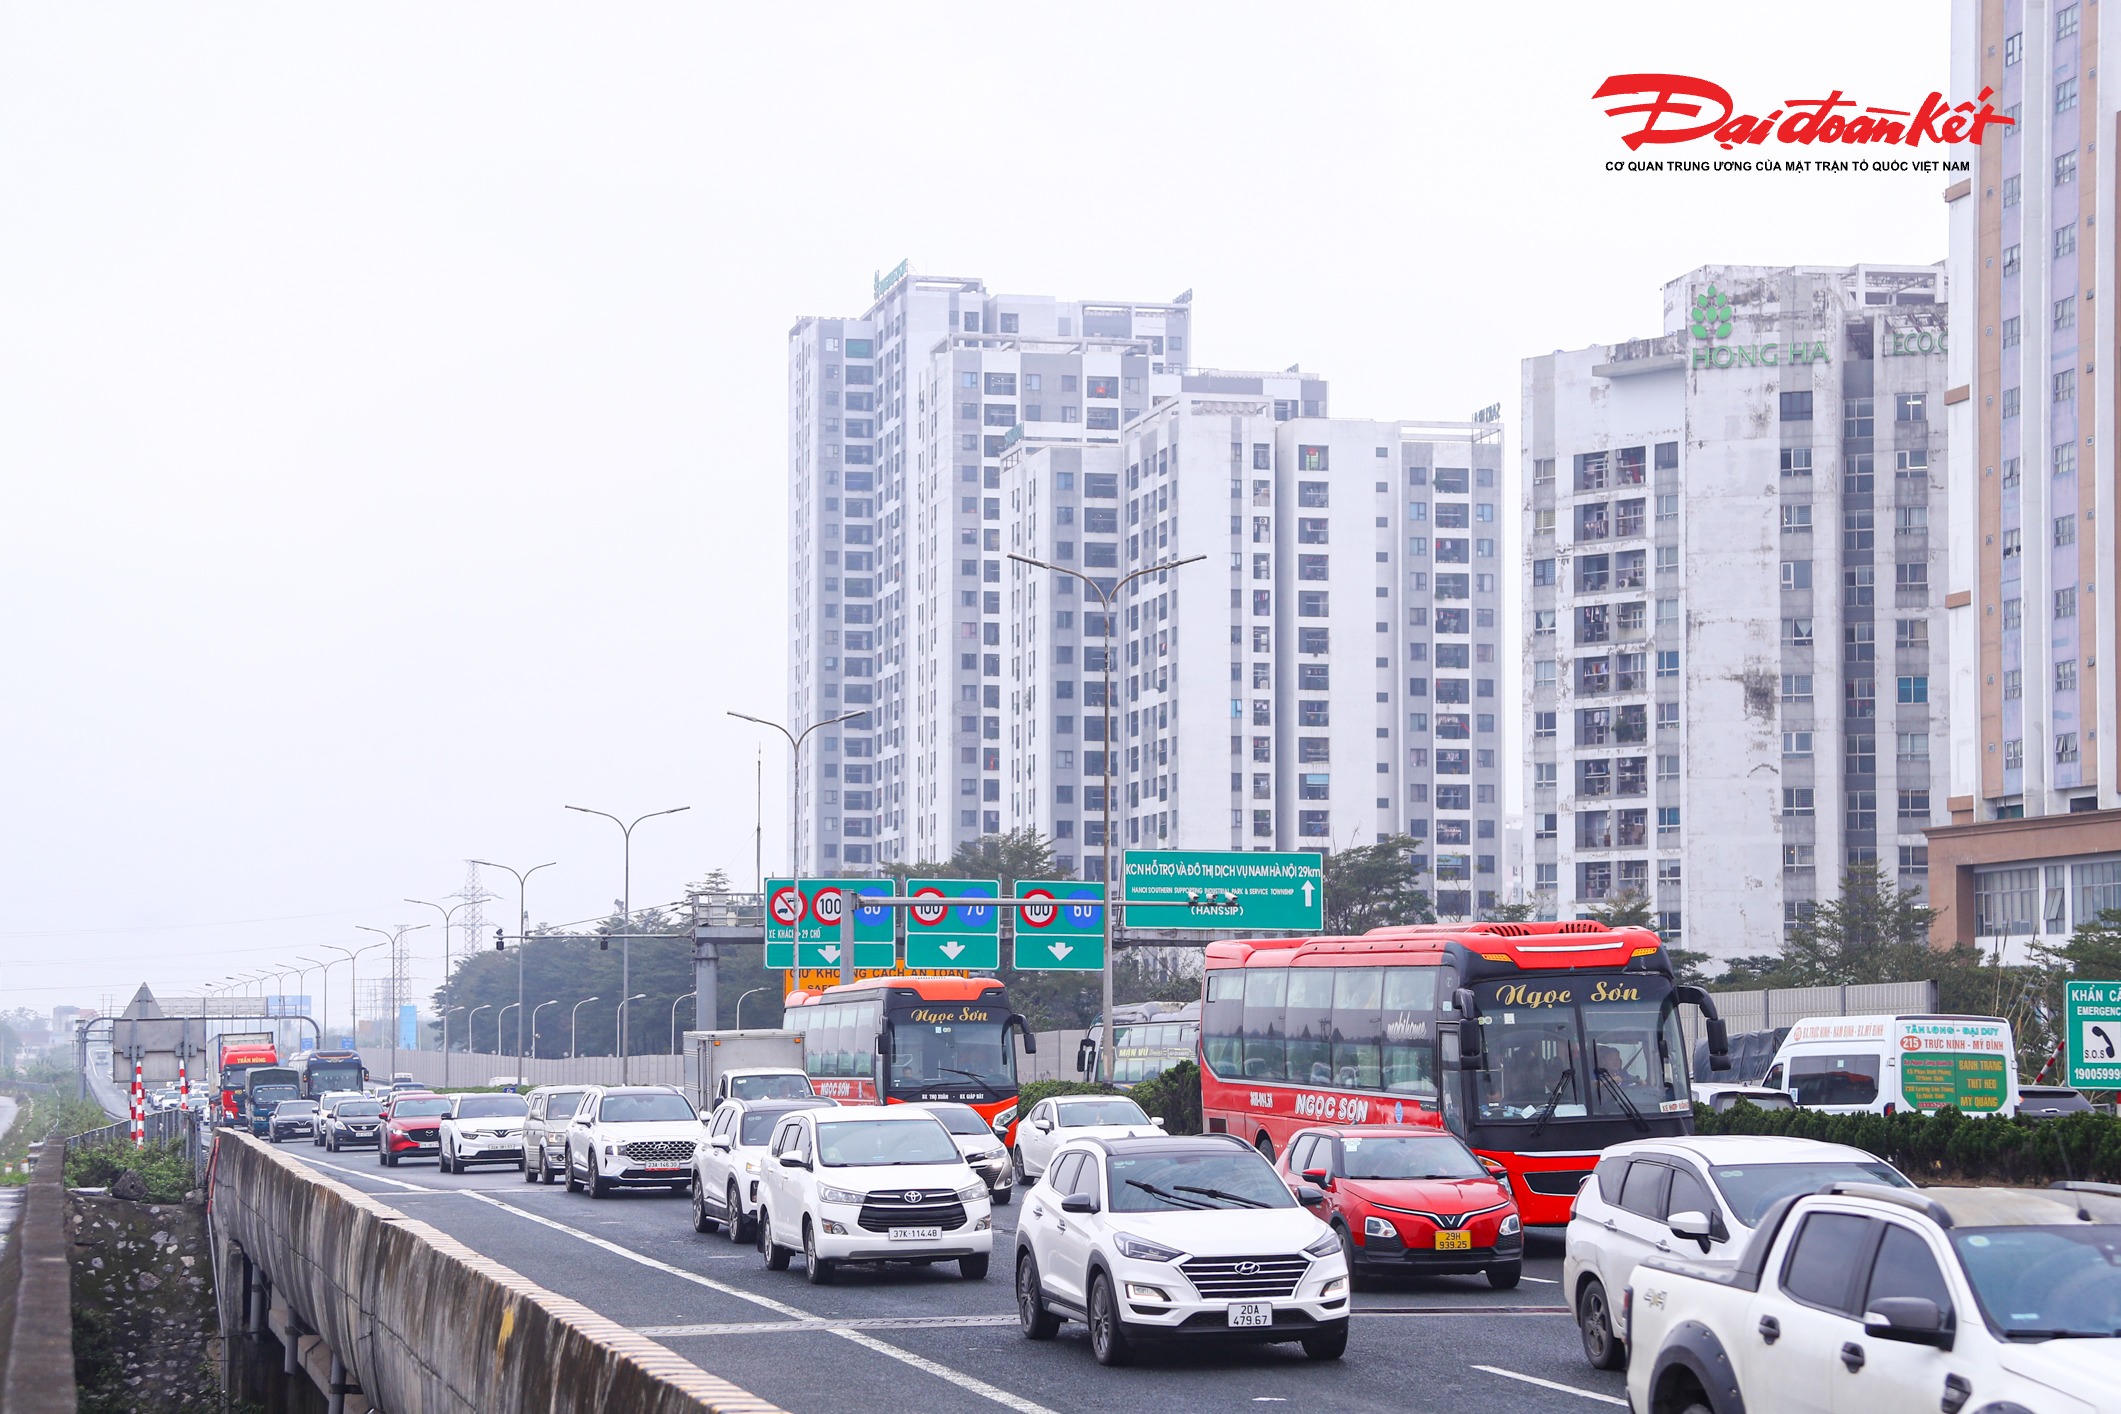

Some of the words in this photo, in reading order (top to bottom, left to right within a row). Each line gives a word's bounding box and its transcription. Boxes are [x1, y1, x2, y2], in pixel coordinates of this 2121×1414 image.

[1788, 340, 1830, 365] HA
[1125, 863, 1144, 875] KCN
[1160, 863, 1175, 877] TRỢ
[1175, 861, 1187, 876] VÀ
[1201, 865, 1214, 878] THỊ
[1215, 865, 1235, 878] DỊCH
[1236, 865, 1248, 878] VỤ
[1248, 865, 1269, 877] NAM
[1269, 863, 1281, 877] HÀ
[1282, 863, 1297, 879] NỘI
[1298, 865, 1320, 878] 29km
[820, 898, 841, 914] 100
[769, 929, 776, 938] XE
[801, 929, 809, 938] 29
[1496, 984, 1572, 1008] Ngọc
[1590, 981, 1640, 1002] Sơn
[910, 1008, 955, 1024] Ngọc
[959, 1007, 988, 1022] Sơn
[1926, 1026, 1955, 1034] LONG
[1981, 1027, 1999, 1036] DUY
[1903, 1037, 1919, 1048] 215
[1946, 1039, 1966, 1050] NINH
[2085, 1049, 2105, 1059] S.O.S
[1295, 1093, 1336, 1120] NGỌC
[1338, 1097, 1369, 1122] SƠN
[1446, 1232, 1461, 1241] 29H
[1439, 1241, 1468, 1249] 939.25
[1241, 1304, 1260, 1315] 20A
[1233, 1315, 1268, 1326] 479.67
